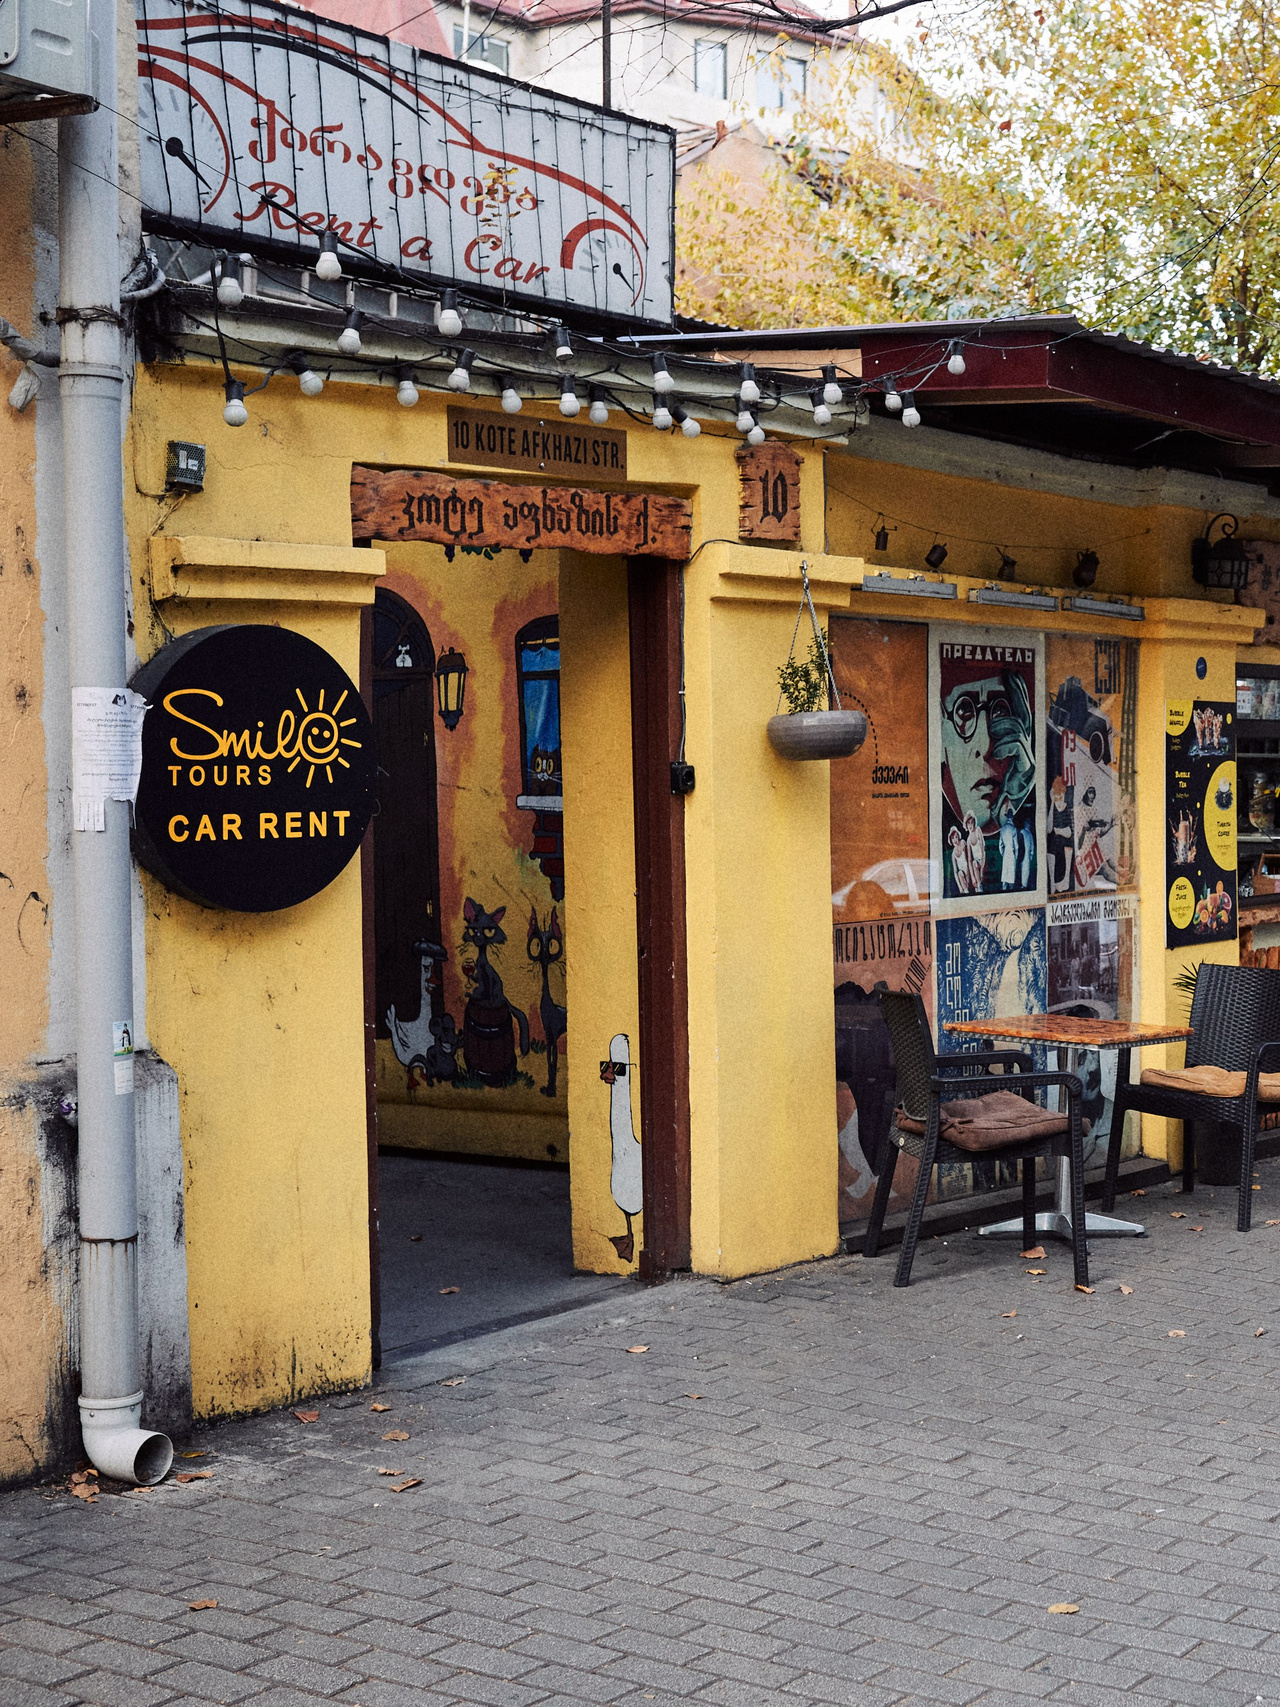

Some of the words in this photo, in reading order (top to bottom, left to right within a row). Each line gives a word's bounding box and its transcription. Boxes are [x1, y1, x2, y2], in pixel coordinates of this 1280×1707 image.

[234, 182, 383, 247] Rent
[401, 236, 433, 262] a
[464, 234, 550, 284] Car
[453, 420, 470, 450] 10
[475, 423, 517, 456] KOTE
[521, 429, 587, 464] AFKHAZI
[591, 440, 624, 469] STR.
[398, 487, 485, 540] კოტე
[503, 488, 619, 543] აფხაზის
[759, 469, 788, 524] 10
[943, 645, 1033, 663] ПРЕДАТЕЛЬ
[168, 765, 272, 787] TOURS
[872, 766, 909, 784] ქვევრი
[168, 814, 243, 843] CAR
[259, 811, 351, 839] RENT
